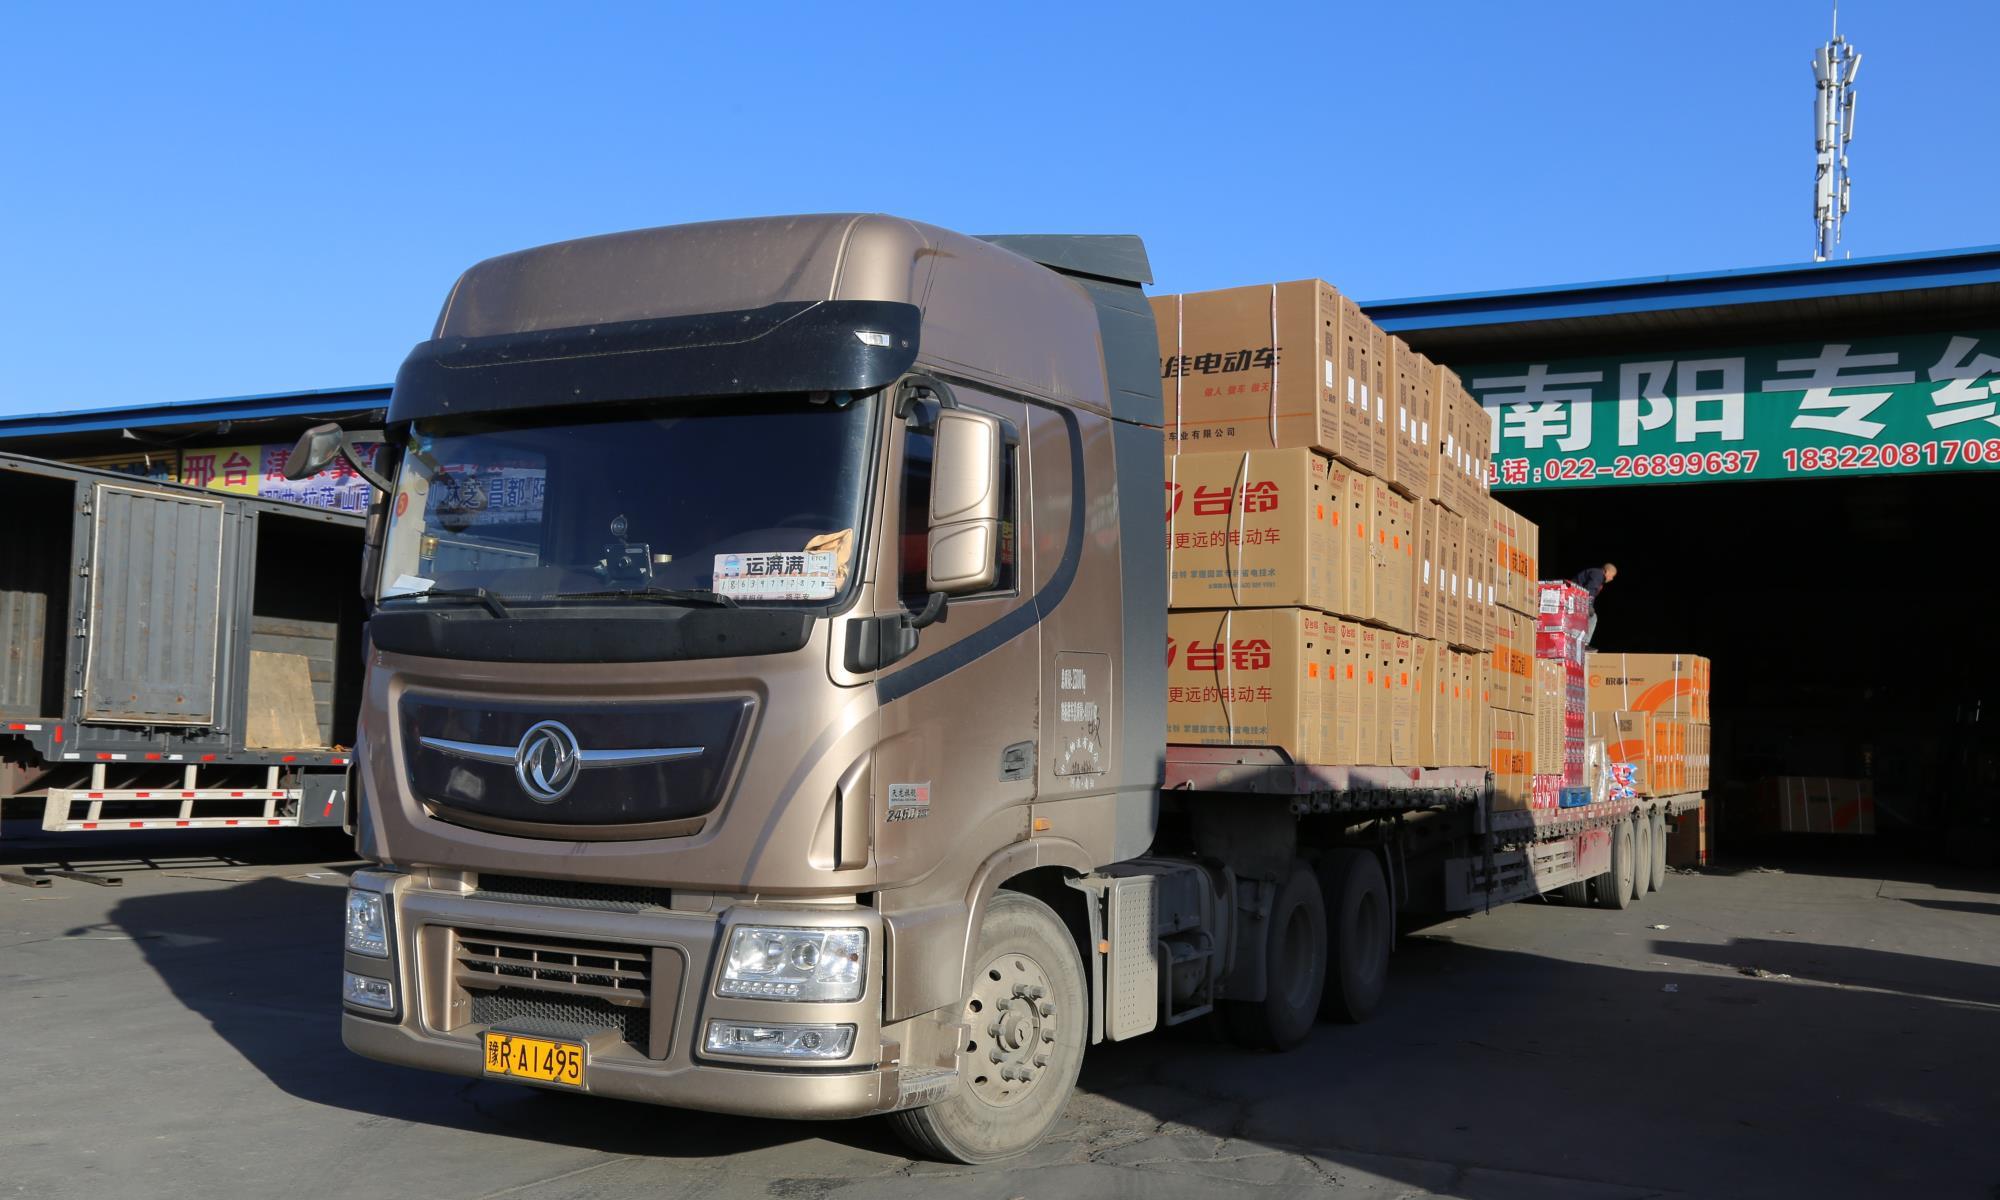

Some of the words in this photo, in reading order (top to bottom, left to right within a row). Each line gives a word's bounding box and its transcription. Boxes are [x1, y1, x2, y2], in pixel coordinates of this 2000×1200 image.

[1160, 347, 1282, 378] 佳电动车
[184, 451, 252, 488] 邢台
[487, 478, 525, 509] 昌都
[1193, 480, 1280, 516] 台铃
[1166, 527, 1281, 550] 更远的电动车
[746, 556, 804, 576] 运满满
[1186, 639, 1271, 671] 台铃
[1168, 685, 1273, 704] 更远的电动车
